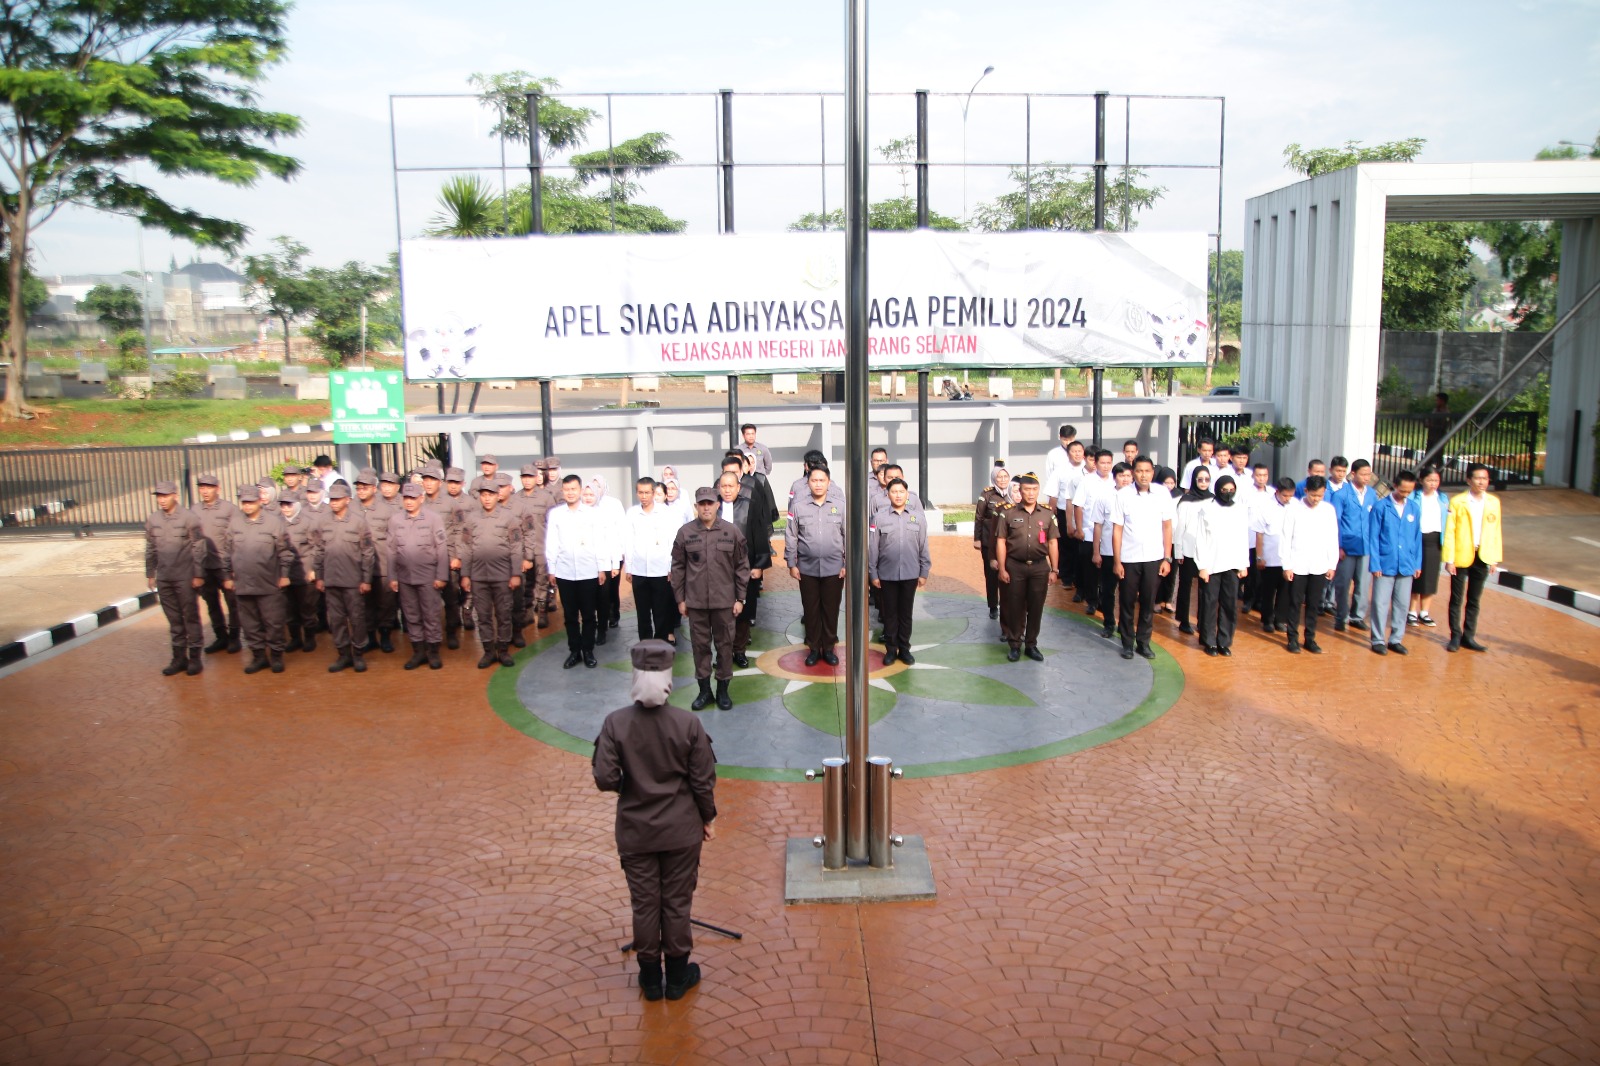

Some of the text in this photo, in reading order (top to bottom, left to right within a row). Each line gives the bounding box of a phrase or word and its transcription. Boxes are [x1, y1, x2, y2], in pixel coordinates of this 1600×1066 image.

[544, 296, 1087, 337] APEL SIAGA ADHYAKSA AGA PEMILU 2024
[661, 334, 977, 362] KEJAKSAAN NEGERI TANRANG SELATAN
[362, 423, 398, 432] KUMPUL
